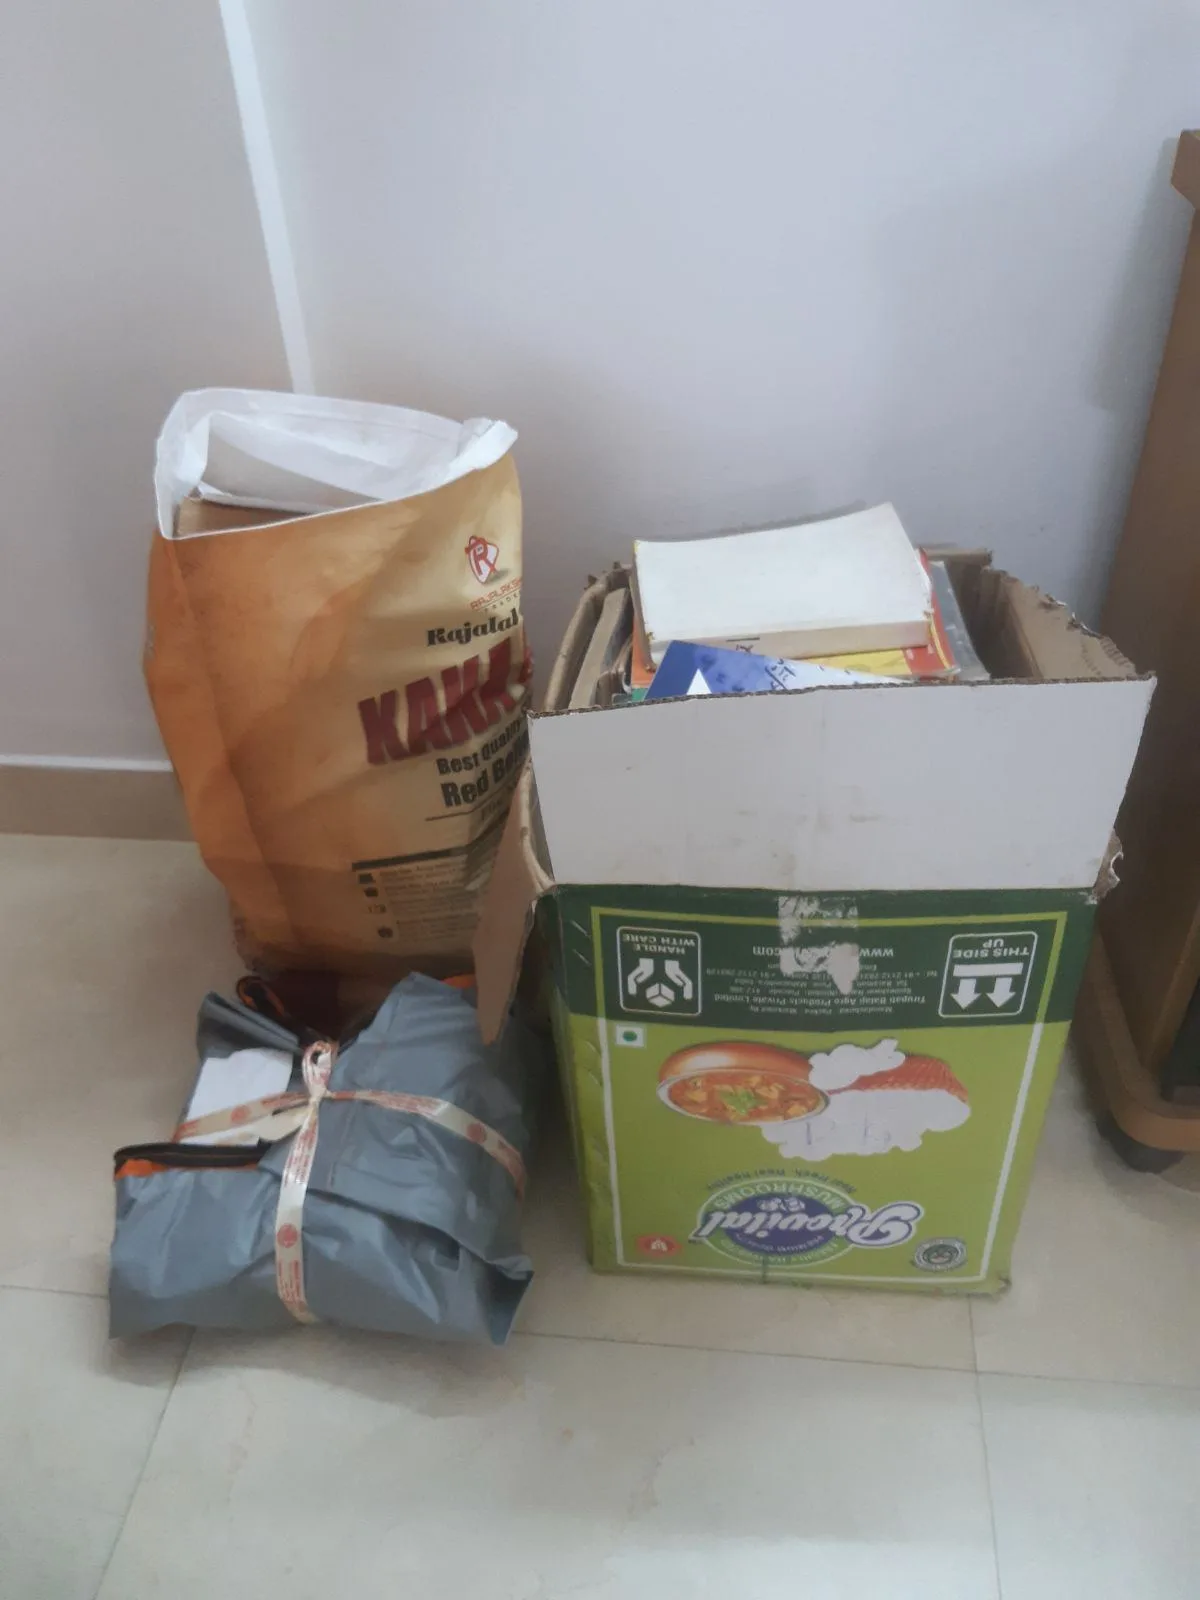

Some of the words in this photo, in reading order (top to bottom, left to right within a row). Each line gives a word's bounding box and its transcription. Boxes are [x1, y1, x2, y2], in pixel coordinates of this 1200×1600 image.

[436, 753, 480, 775] Best
[441, 768, 489, 808] Red
[622, 934, 656, 944] CARE
[660, 937, 696, 946] WITH
[982, 938, 1004, 948] UP
[633, 944, 685, 954] HANDLE
[952, 948, 989, 958] SIDE
[992, 946, 1029, 957] THIS
[752, 996, 786, 1006] Private
[789, 997, 830, 1006] Products
[833, 996, 857, 1006] Agro
[859, 996, 886, 1004] Balaji
[889, 996, 925, 1004] Tirupati
[713, 1182, 844, 1210] MUSHROOMS
[691, 1202, 923, 1248] Provital
